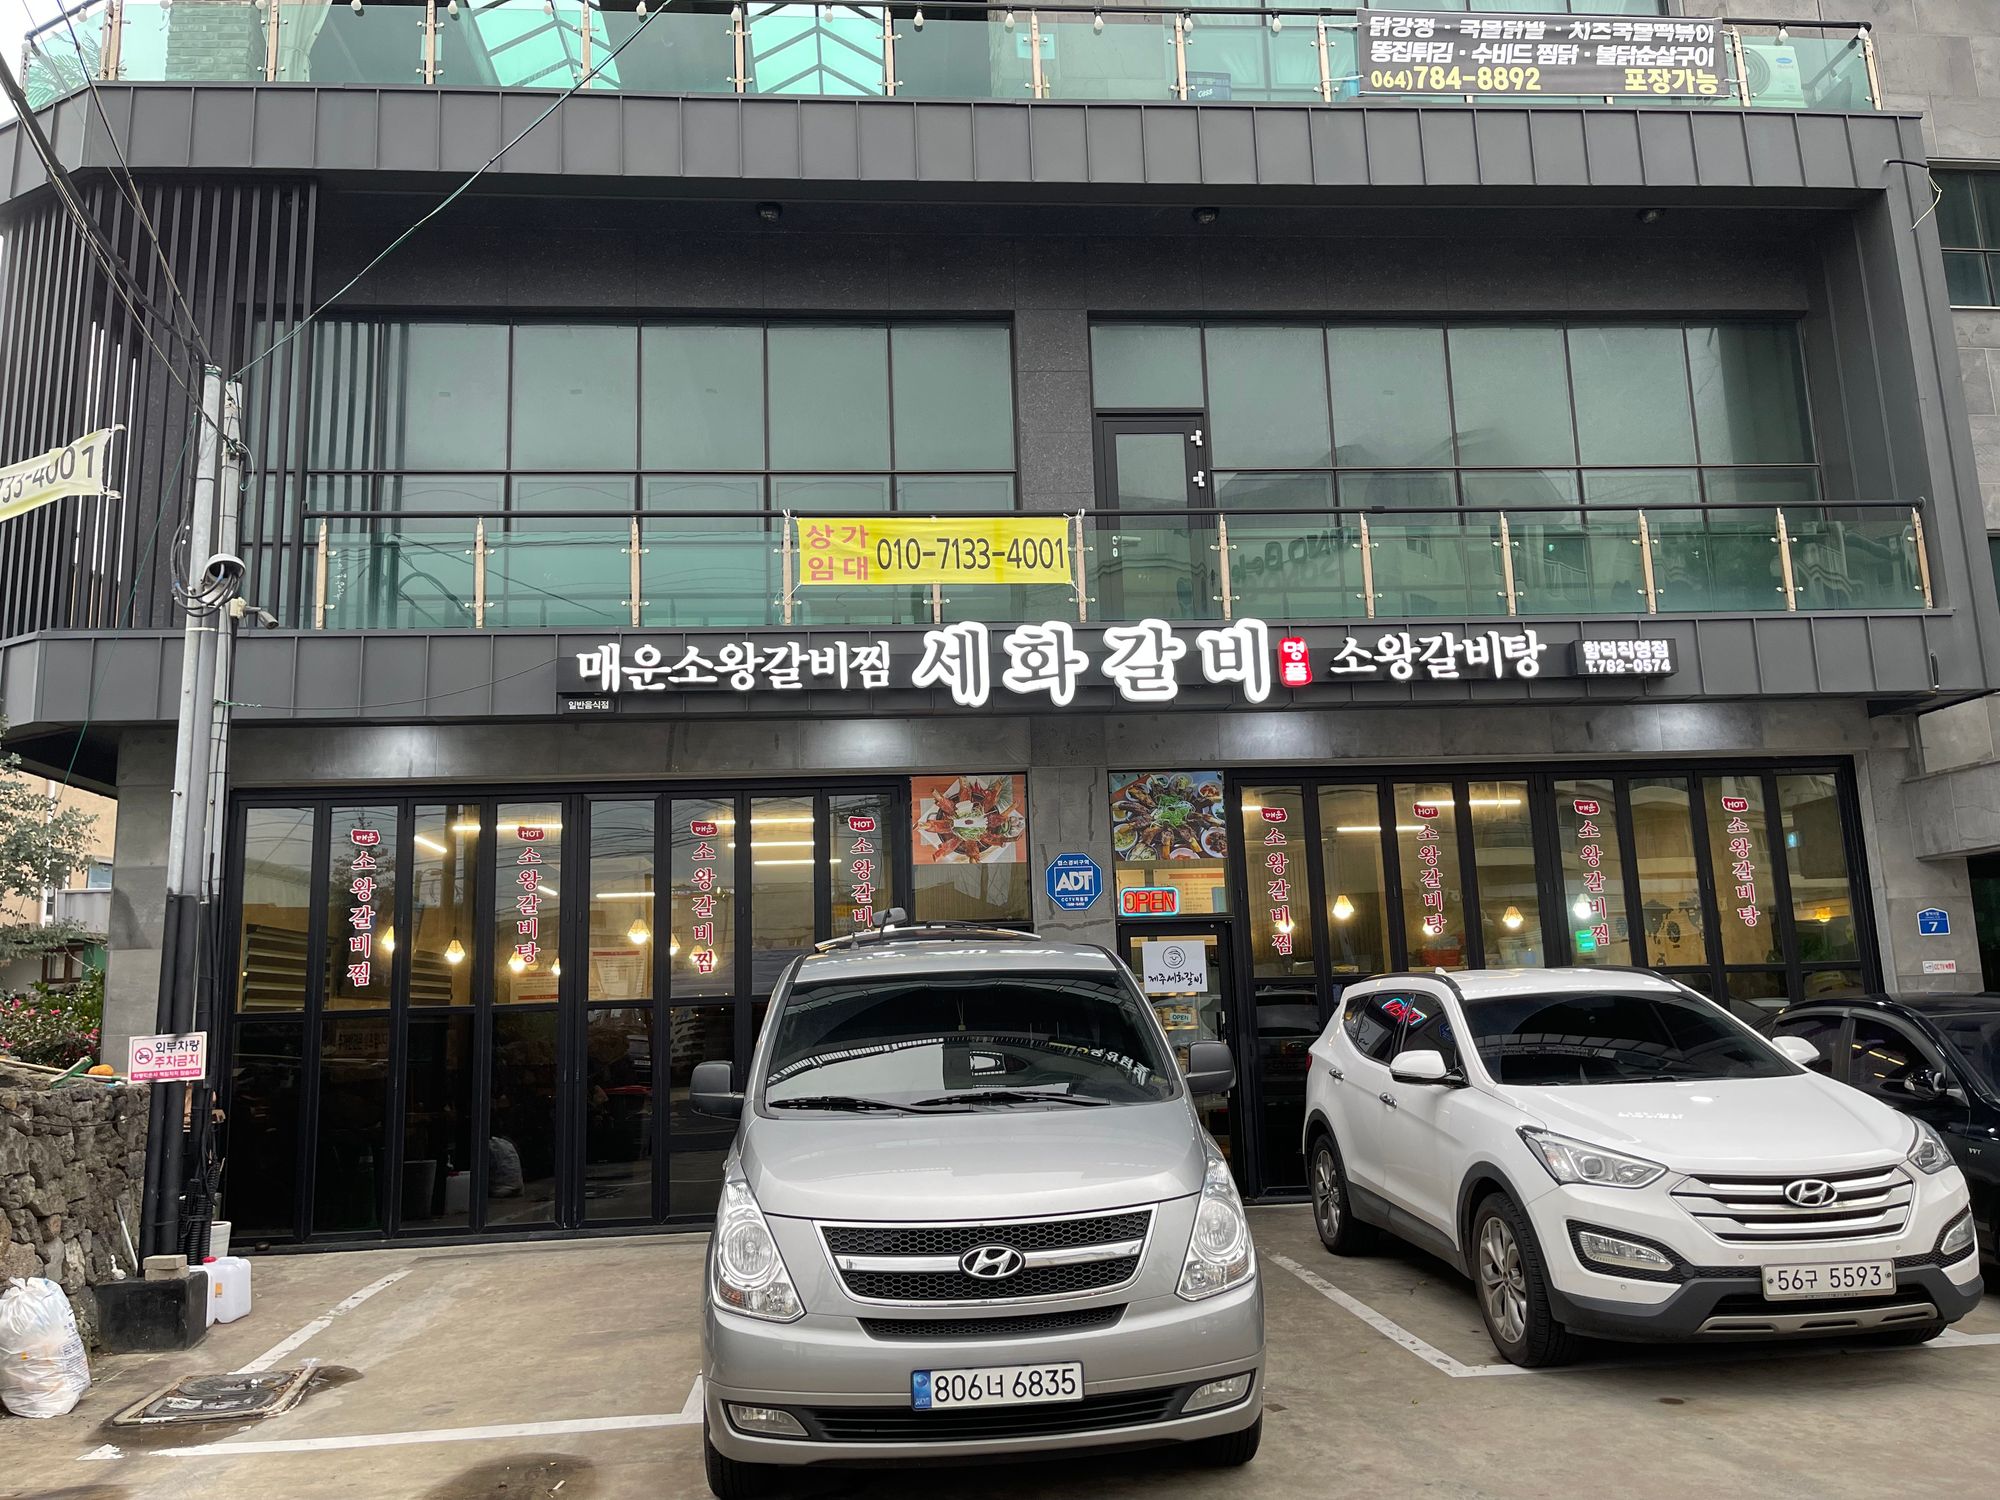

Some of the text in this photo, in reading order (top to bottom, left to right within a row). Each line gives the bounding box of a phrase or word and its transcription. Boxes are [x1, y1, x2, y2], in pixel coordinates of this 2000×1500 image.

[1369, 16, 1714, 43] 닭강정 국물닭발 치즈국물떡볶이
[1370, 40, 1715, 67] 똥집튀김 수비드 찜닭 불닭순살구이
[1624, 68, 1719, 94] 포장가능
[0, 445, 95, 503] 33-4001
[806, 524, 870, 549] 상가
[876, 537, 1064, 570] 010-7133-4001
[808, 555, 870, 581] 임대
[1283, 640, 1308, 683] 명품
[1330, 630, 1548, 680] 소왕갈비탕
[1583, 640, 1669, 660] 함덕직영점
[911, 618, 1272, 708] 세화갈비
[1585, 659, 1671, 673] T.782-0574
[568, 700, 609, 710] 일반음식점
[1265, 810, 1284, 820] 매운
[1417, 807, 1435, 816] HOT
[1578, 803, 1597, 813] 매운
[1727, 800, 1745, 809] HOT
[521, 830, 541, 838] HOT
[695, 824, 715, 834] 매운
[853, 820, 872, 829] HOT
[356, 832, 376, 843] 매운
[1055, 870, 1093, 891] ADT
[1416, 824, 1448, 935] 소왕갈비탕
[1578, 819, 1610, 946] 소왕갈비찜
[1726, 816, 1761, 927] 소왕갈비탕
[850, 837, 876, 933] 소왕갈비
[1263, 827, 1293, 956] 소왕갈비찜
[515, 847, 543, 965] 소왕갈비탕
[691, 842, 717, 974] 소왕갈비찜
[1123, 890, 1177, 913] OPEN
[347, 850, 377, 988] 소왕갈비찜
[1928, 921, 1938, 932] 7
[1147, 971, 1203, 987] 제주세화갈비
[1172, 1013, 1189, 1021] OPEN
[155, 1039, 200, 1053] 외부차량
[154, 1053, 200, 1068] 주차금지
[1778, 1265, 1881, 1290] 56구 5593
[934, 1368, 1076, 1402] 806너 6835
